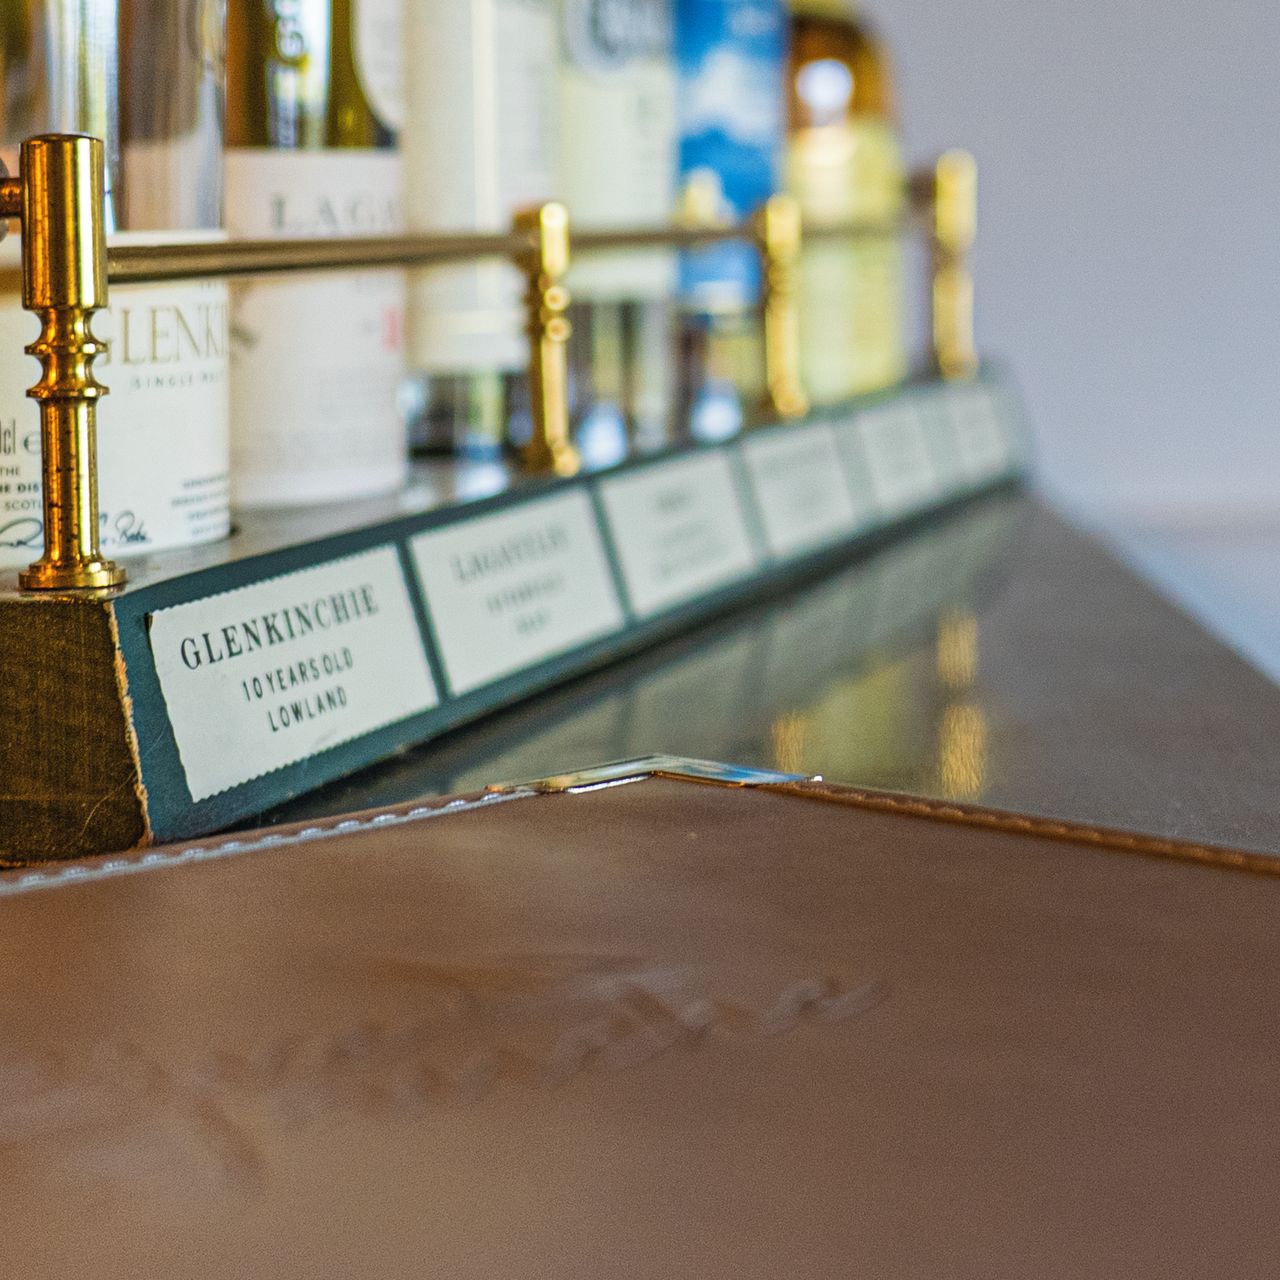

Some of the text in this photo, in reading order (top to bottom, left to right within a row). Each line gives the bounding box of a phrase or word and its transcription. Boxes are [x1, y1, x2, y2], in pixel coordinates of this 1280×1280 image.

[0, 467, 19, 477] THE
[180, 583, 380, 671] GLENKINCHIE
[242, 646, 355, 702] 10 YEARS OLD
[267, 684, 348, 733] LOWLAND
